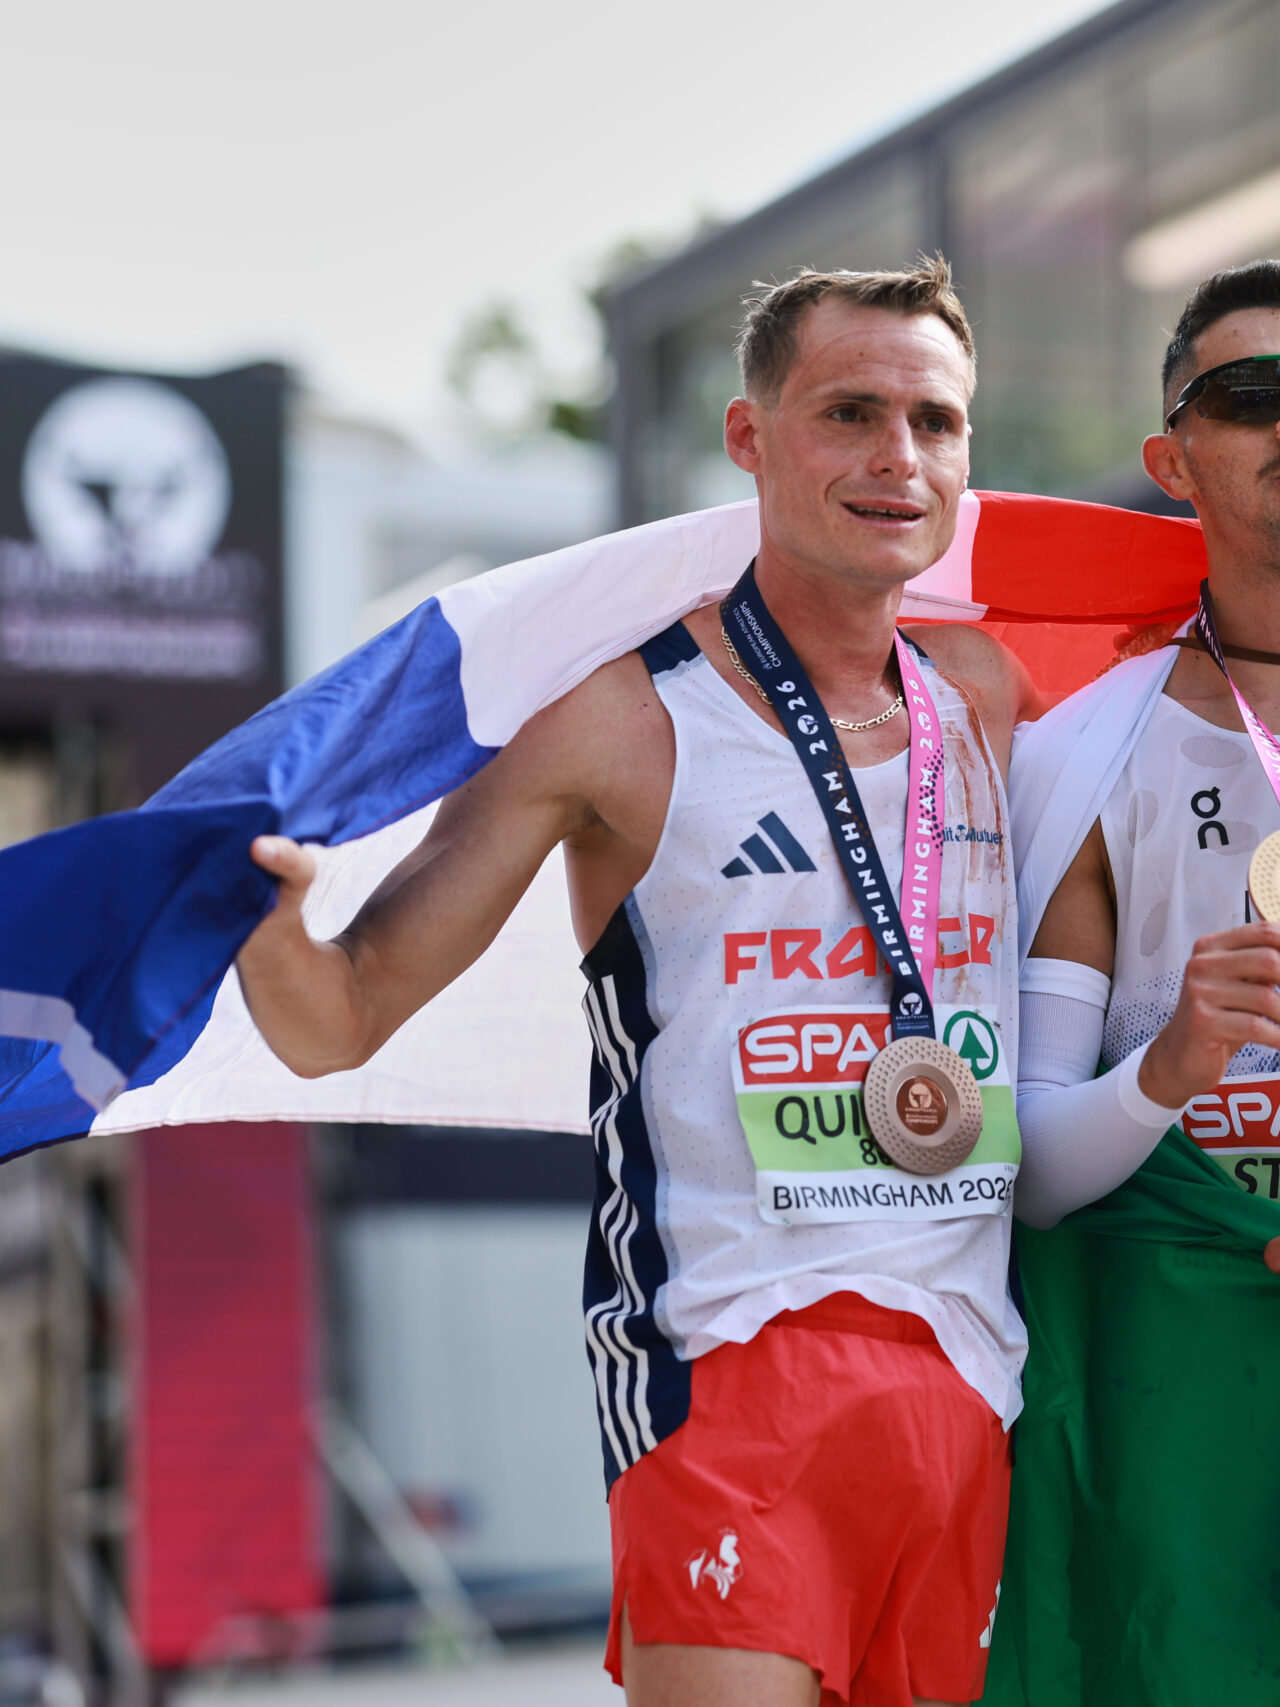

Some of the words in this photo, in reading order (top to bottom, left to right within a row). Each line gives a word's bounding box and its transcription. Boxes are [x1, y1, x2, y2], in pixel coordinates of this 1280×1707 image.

[740, 601, 781, 667] CHAMPIONSHIPS
[822, 771, 914, 976] BIRMINGHAM
[724, 912, 995, 985] FRACE
[744, 1022, 892, 1075] SPA
[773, 1182, 954, 1211] BIRMINGHAM
